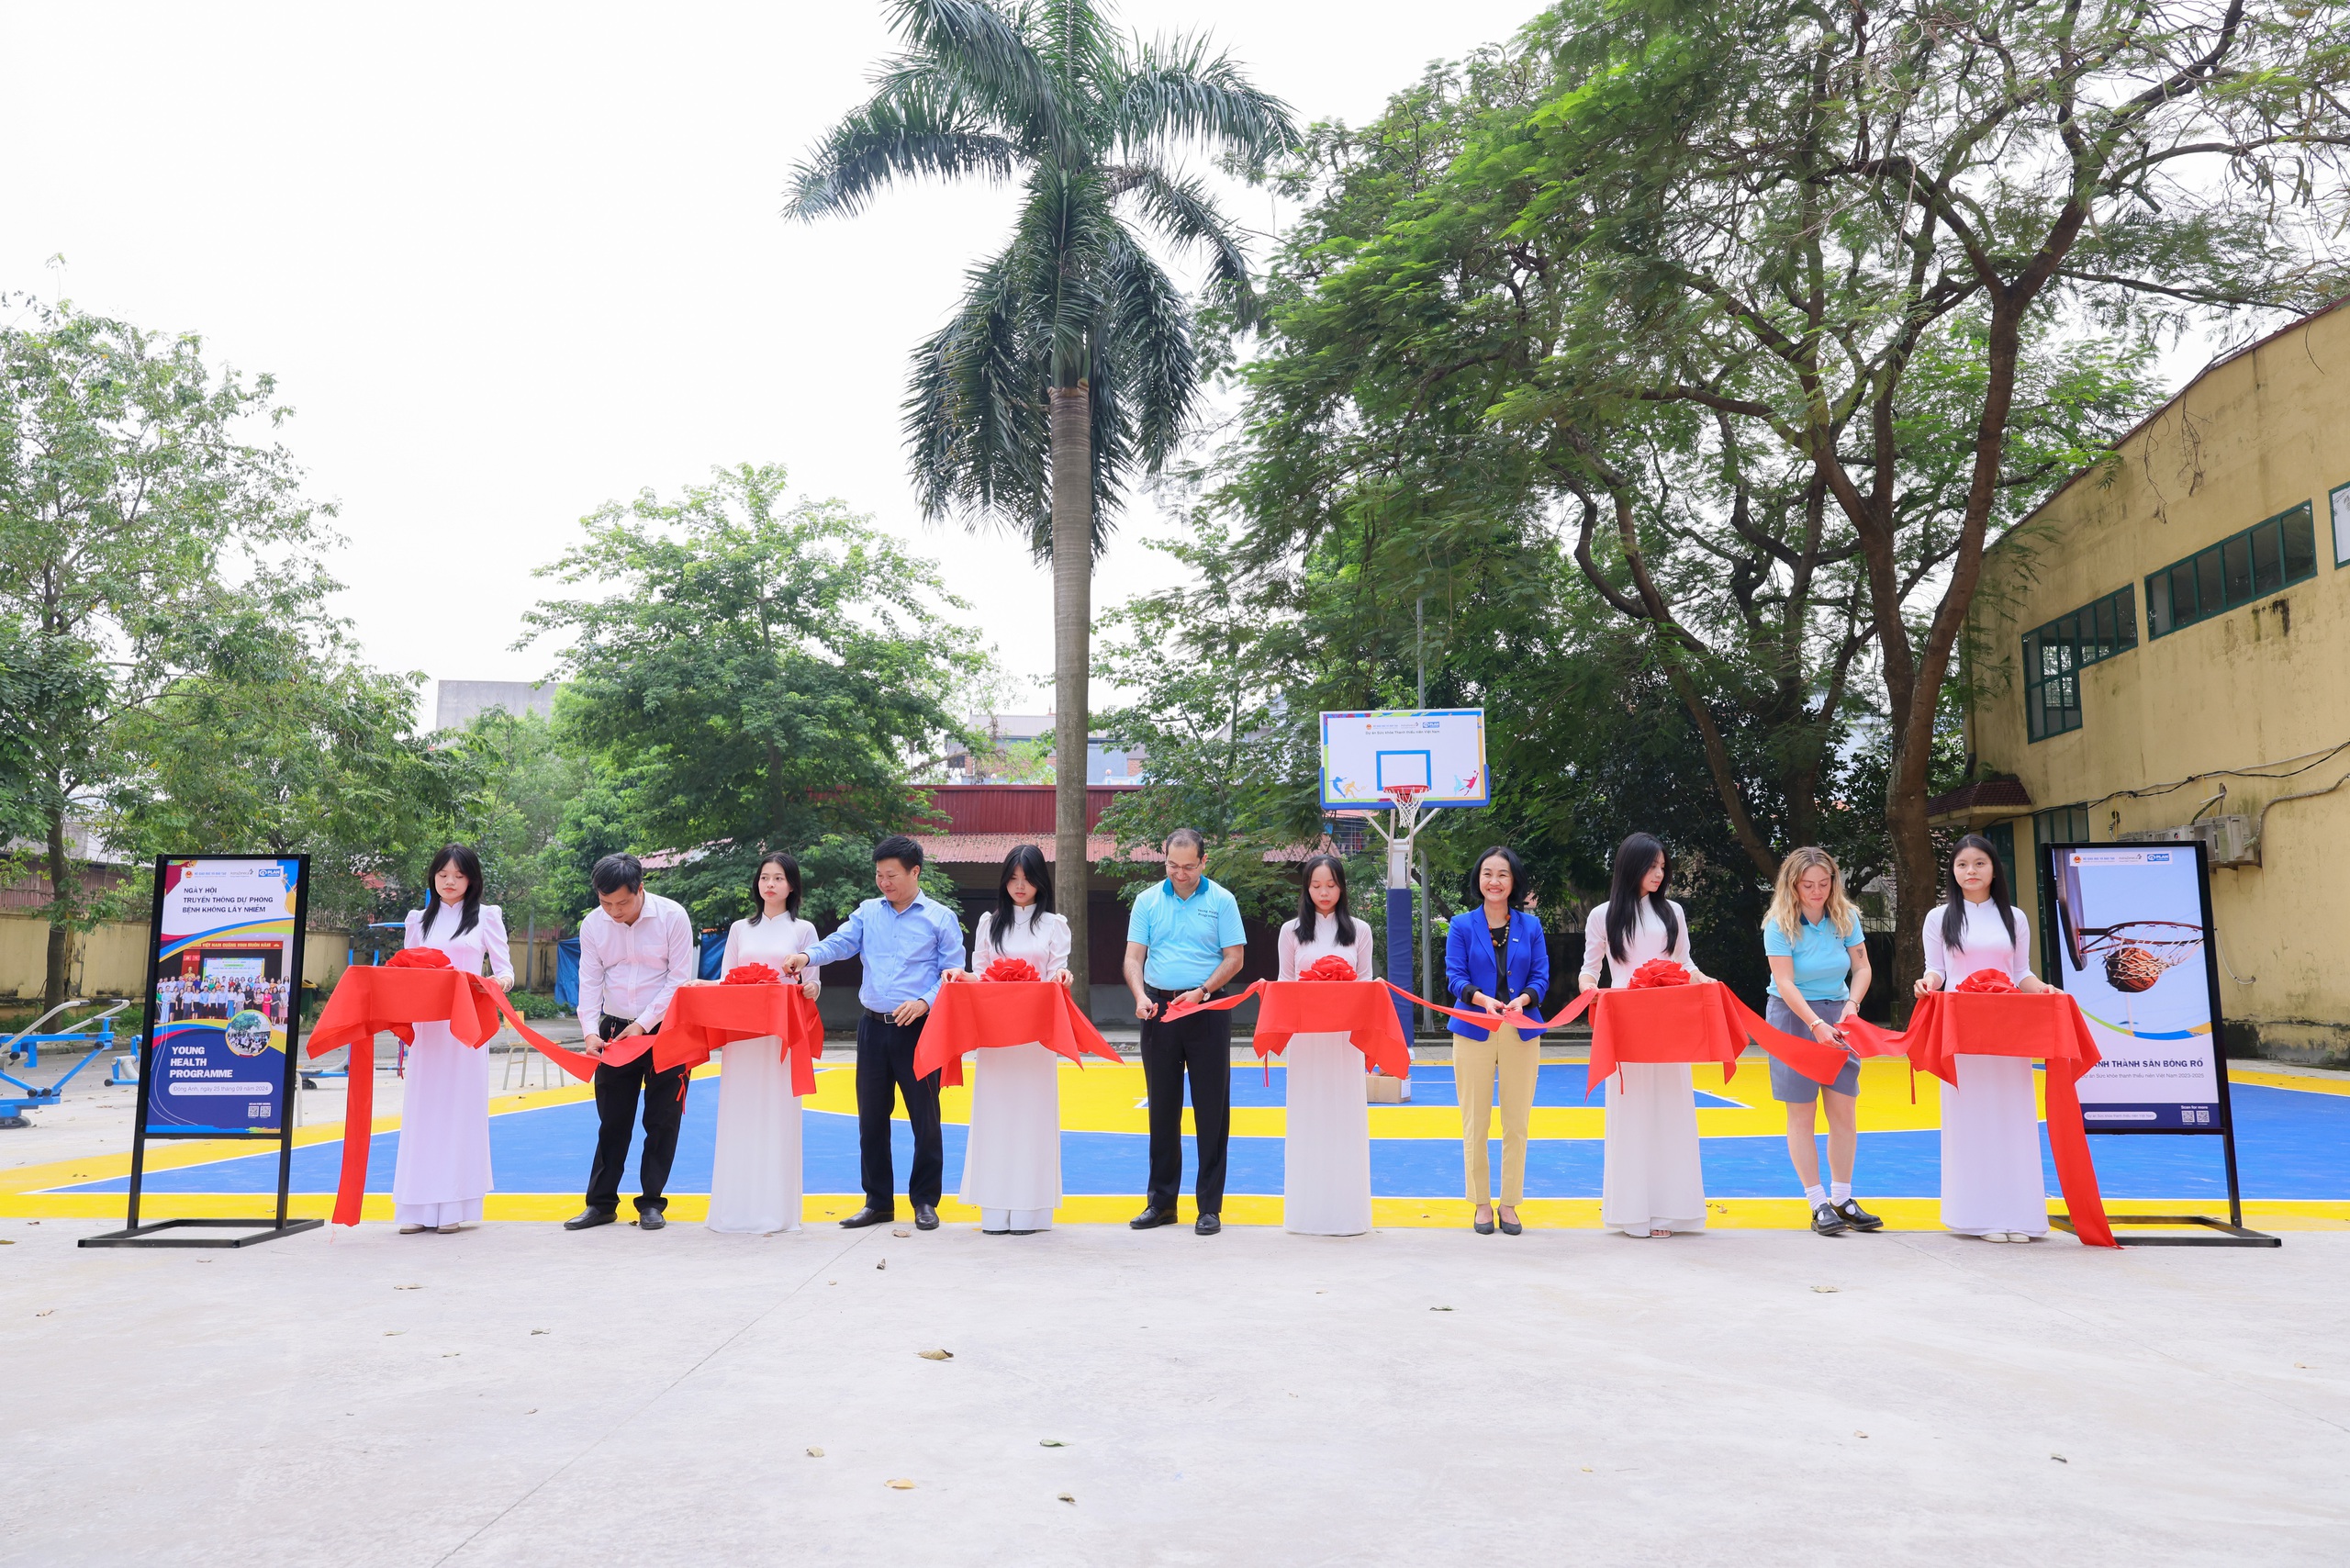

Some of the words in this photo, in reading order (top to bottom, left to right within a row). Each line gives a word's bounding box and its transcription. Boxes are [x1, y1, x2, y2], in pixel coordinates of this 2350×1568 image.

[205, 887, 218, 895] HỘI
[237, 897, 248, 905] DỰ
[182, 906, 201, 914] BỆNH
[172, 1047, 206, 1055] YOUNG
[170, 1058, 207, 1067] HEALTH
[2111, 1058, 2140, 1068] THÀNH
[2143, 1058, 2161, 1068] SÂN
[2163, 1058, 2188, 1068] BÓNG
[169, 1070, 233, 1078] PROGRAMME
